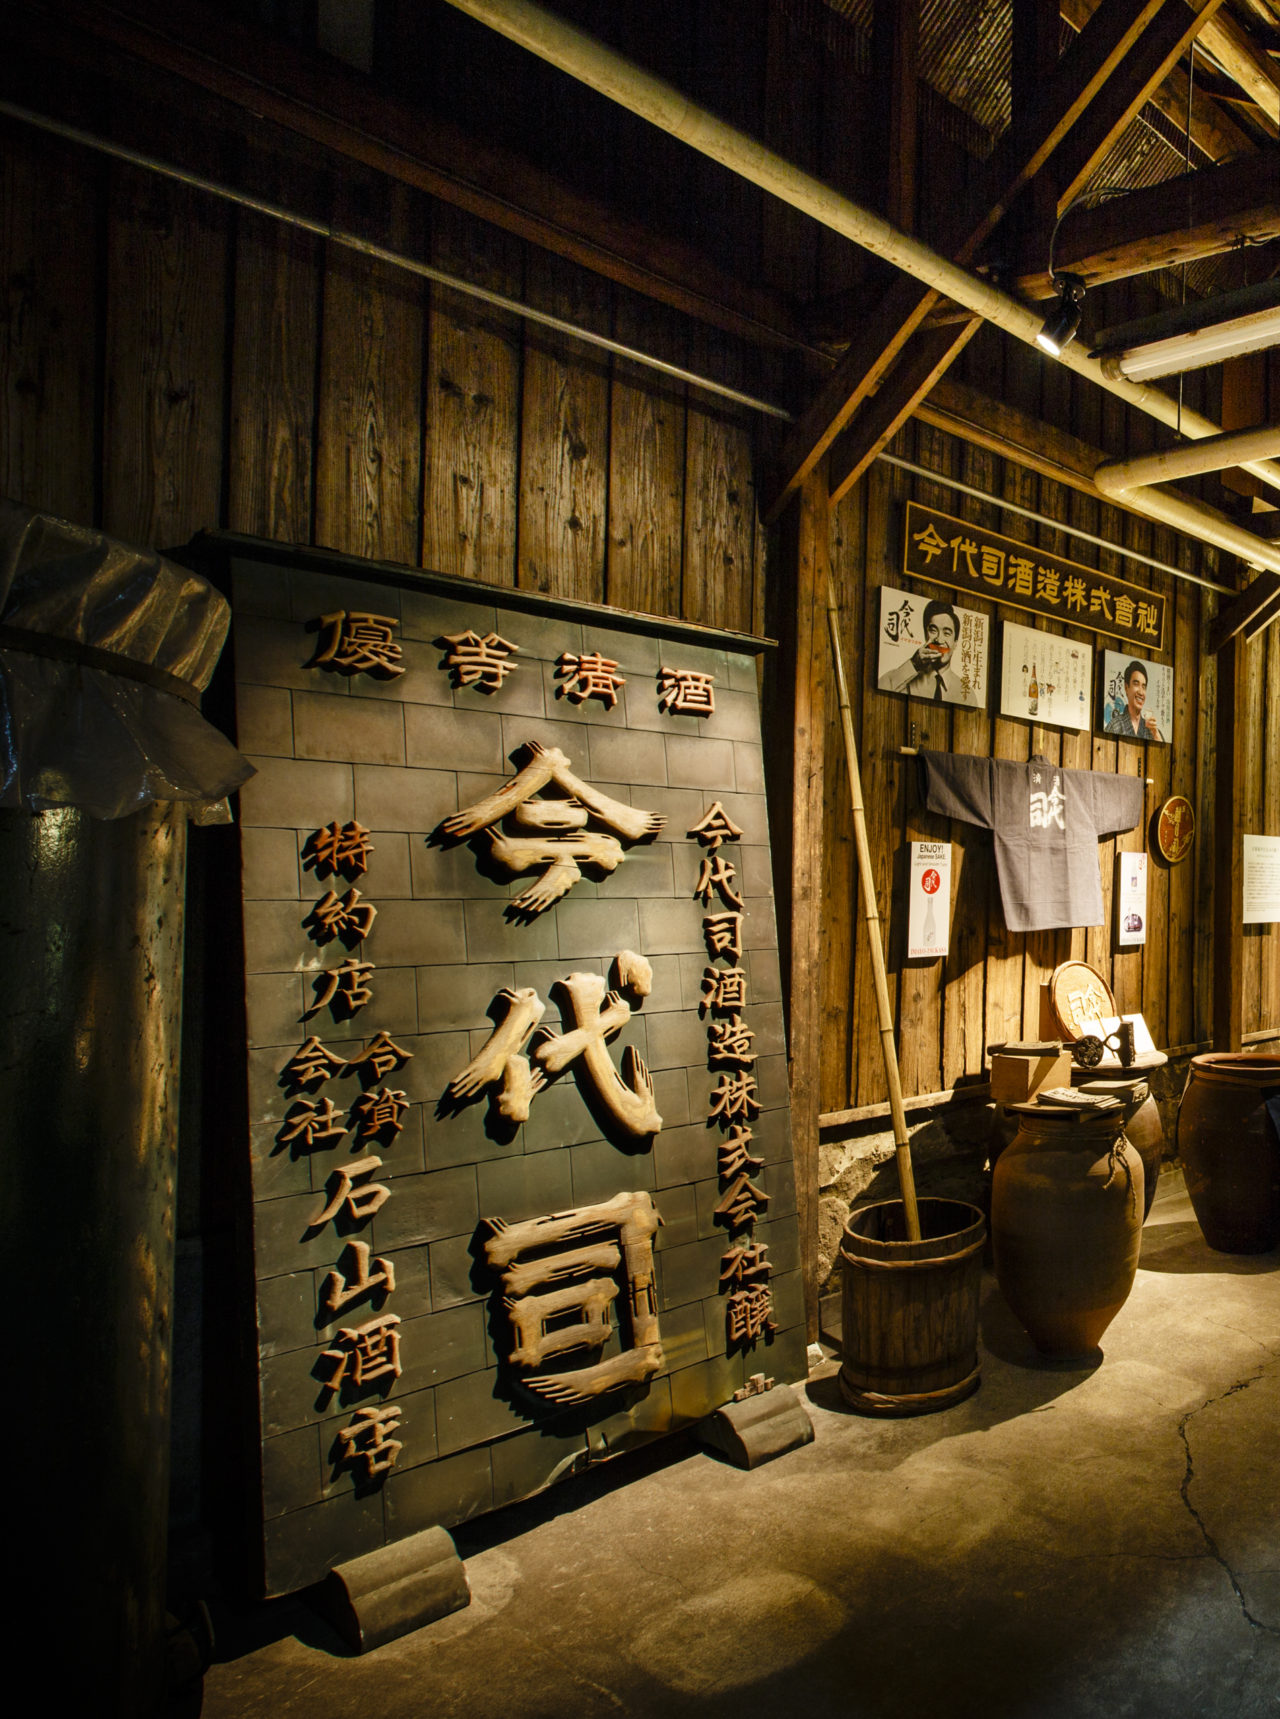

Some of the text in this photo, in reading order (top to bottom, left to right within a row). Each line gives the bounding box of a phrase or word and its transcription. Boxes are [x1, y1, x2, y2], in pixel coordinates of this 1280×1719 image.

[913, 524, 1159, 636] 今代司酒造株式會社
[305, 610, 715, 718] 優等清酒
[960, 613, 973, 701] 新潟の酒を愛す
[972, 616, 985, 690] 新潟に生まれ
[919, 843, 944, 854] ENJOY!
